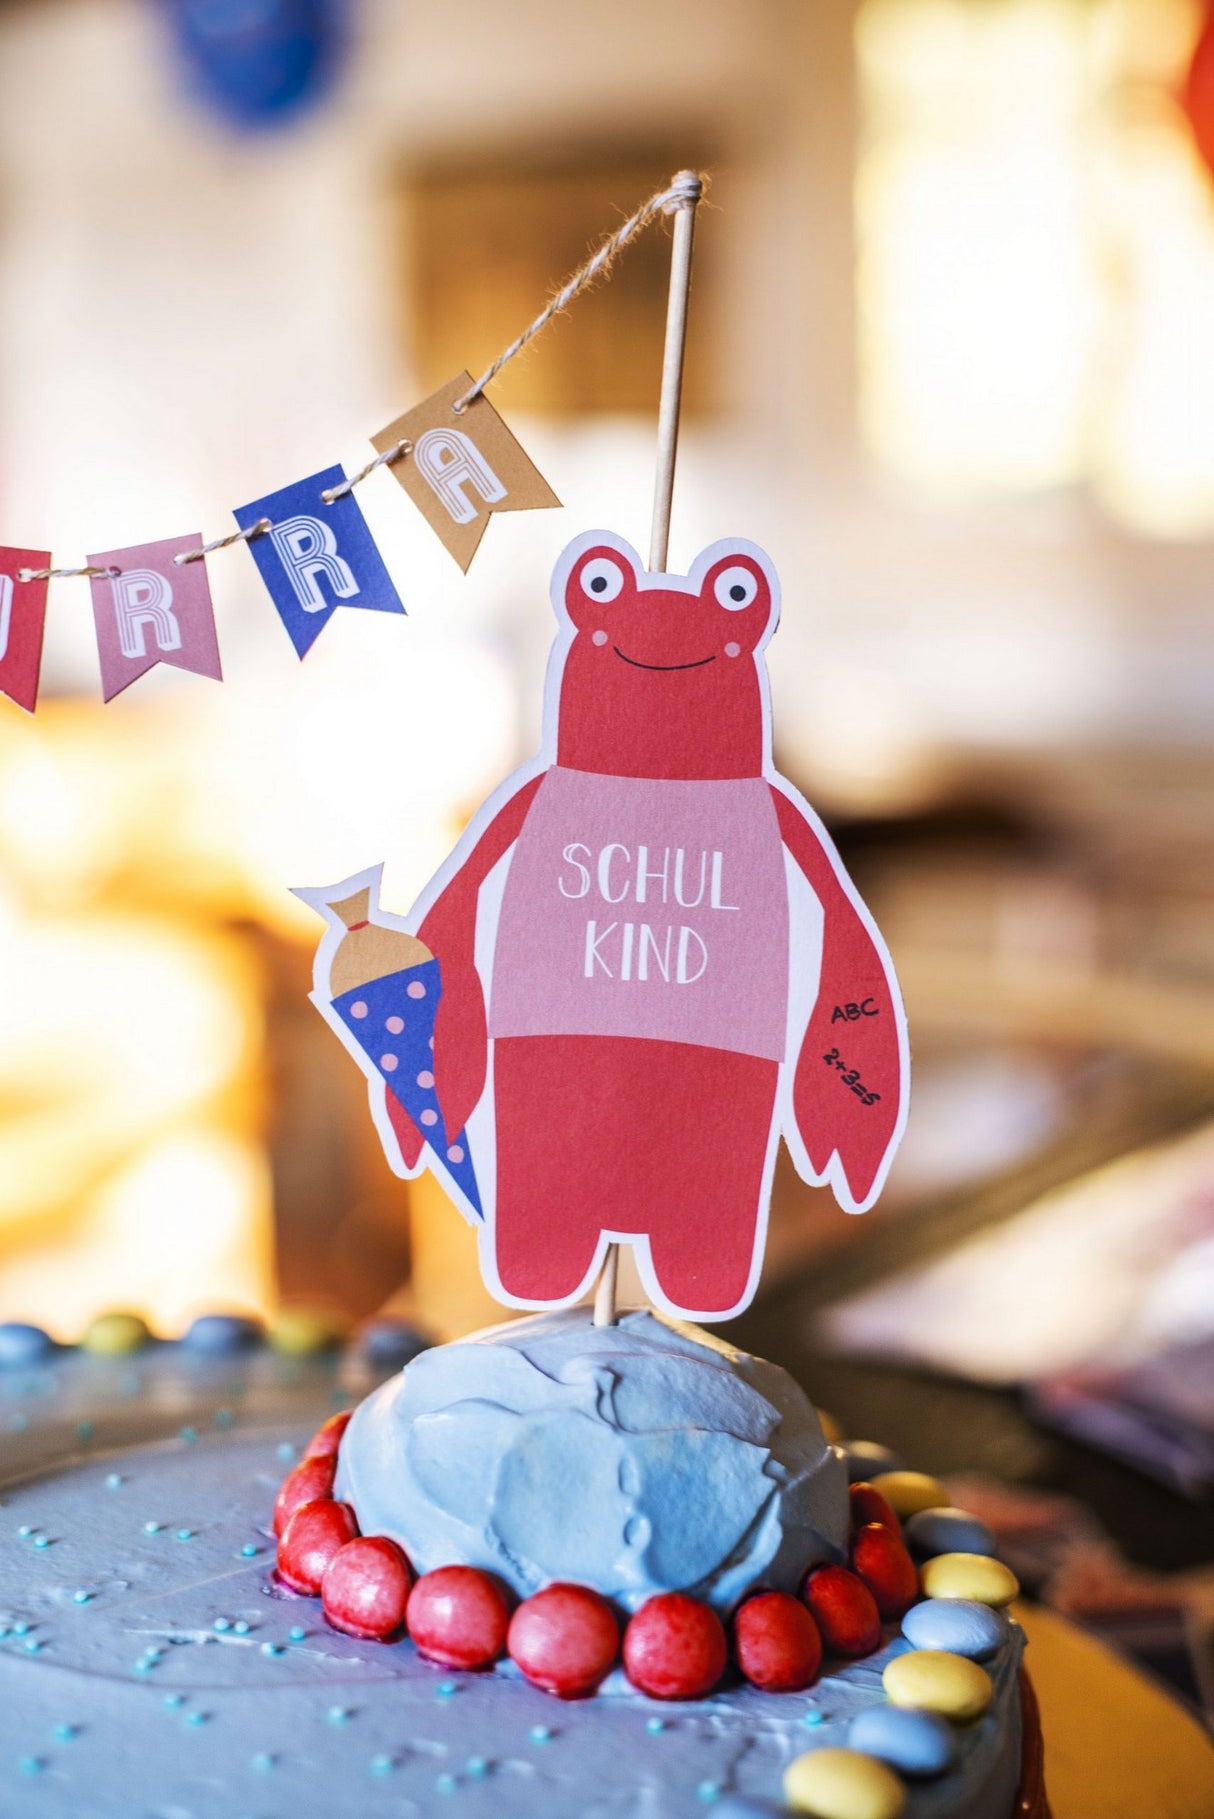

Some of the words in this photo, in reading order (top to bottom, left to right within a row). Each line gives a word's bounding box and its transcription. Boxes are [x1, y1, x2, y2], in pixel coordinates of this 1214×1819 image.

[0, 427, 508, 662] RRA
[558, 843, 740, 910] SCHUL
[584, 920, 708, 984] KIND
[831, 998, 879, 1024] ABC
[823, 1048, 881, 1106] 2+3=5
